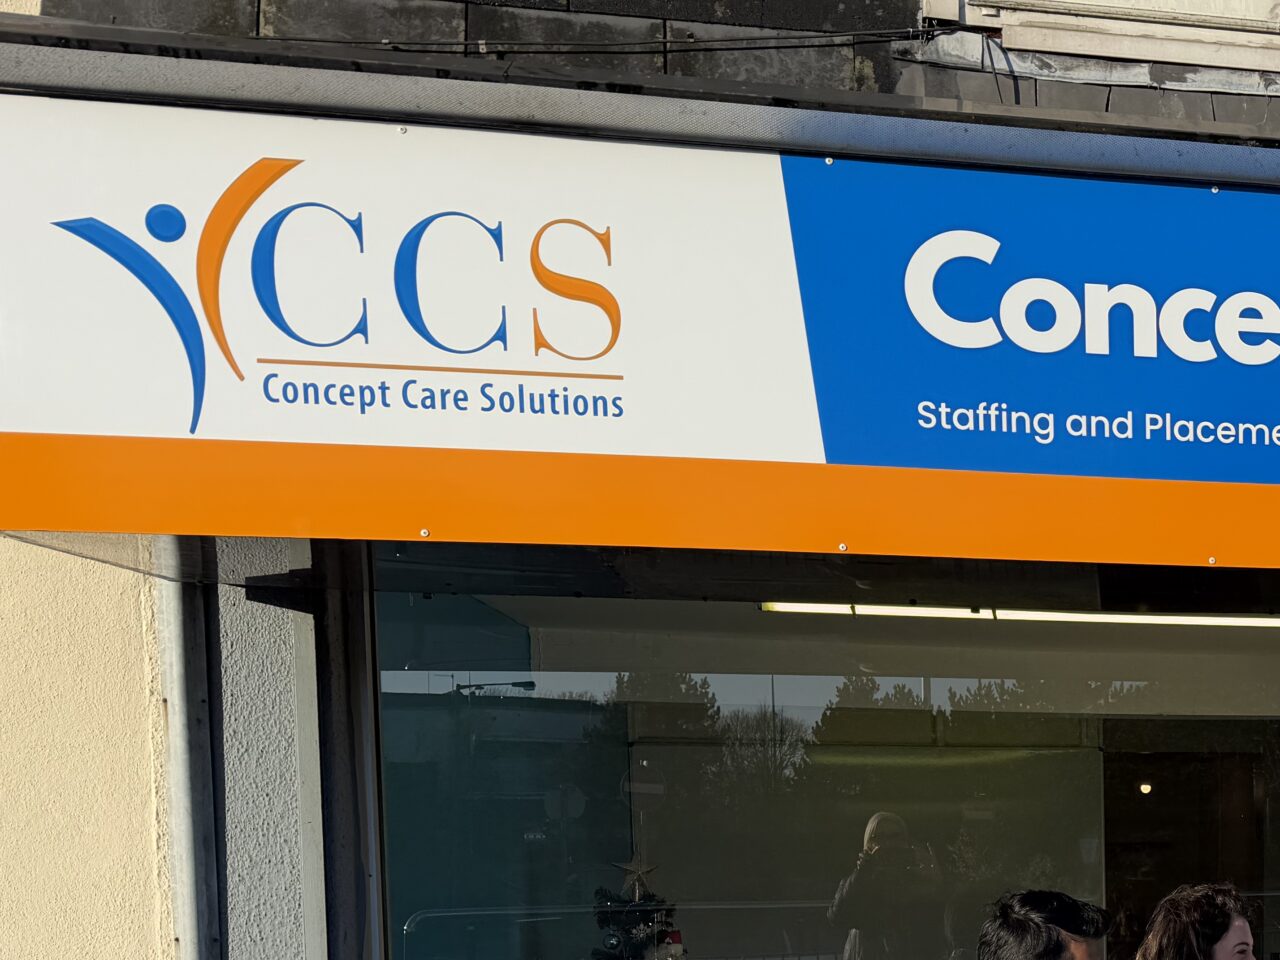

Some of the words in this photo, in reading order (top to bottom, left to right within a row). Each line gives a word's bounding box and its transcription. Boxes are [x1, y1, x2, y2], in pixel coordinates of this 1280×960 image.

[252, 203, 621, 360] CCS
[263, 373, 390, 415] Concept
[401, 379, 469, 412] Care
[480, 383, 625, 418] Solutions
[917, 400, 1055, 445] Staffing
[1065, 410, 1133, 439] and
